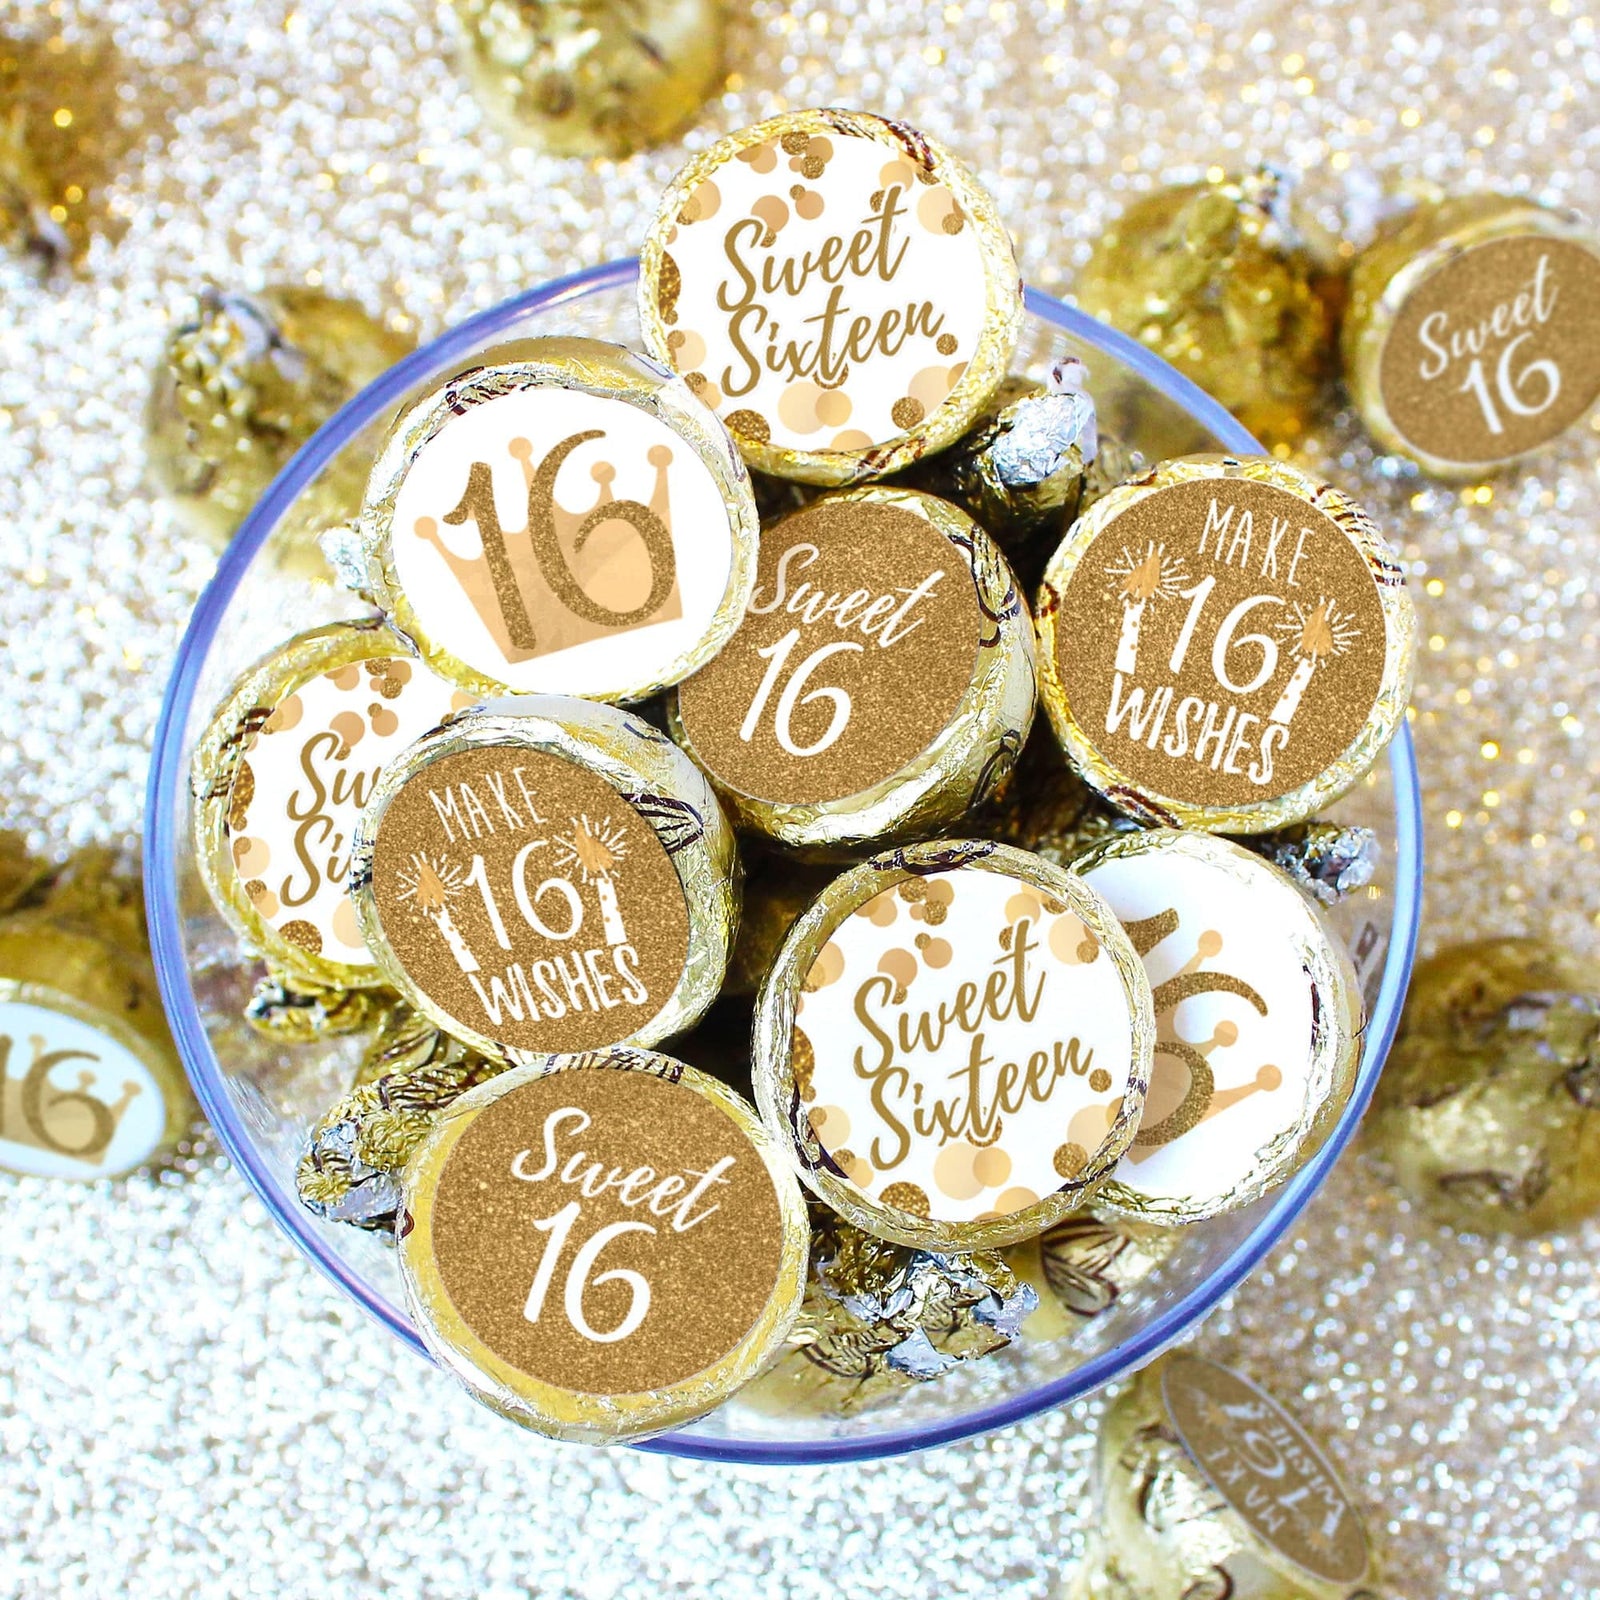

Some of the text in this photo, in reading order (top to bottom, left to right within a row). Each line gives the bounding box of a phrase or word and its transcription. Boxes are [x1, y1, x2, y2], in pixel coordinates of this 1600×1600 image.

[716, 186, 910, 312] Sweet
[720, 285, 945, 397] Sixteen
[1418, 254, 1560, 381] Sweet
[1459, 331, 1561, 435] 16
[442, 429, 677, 650] 16
[747, 543, 946, 648] Sweet
[1197, 498, 1315, 587] MAKE
[739, 628, 865, 757] 16
[1168, 575, 1287, 694] 16
[1105, 672, 1290, 785] WISHES
[428, 767, 548, 843] MAKE
[462, 839, 584, 950] 16
[468, 945, 649, 1026] WISHES
[853, 919, 1046, 1080] Sweet
[870, 1033, 1094, 1171] Sixteen
[511, 1107, 737, 1232] Sweet
[523, 1201, 657, 1344] 16
[1229, 1430, 1310, 1513] 16
